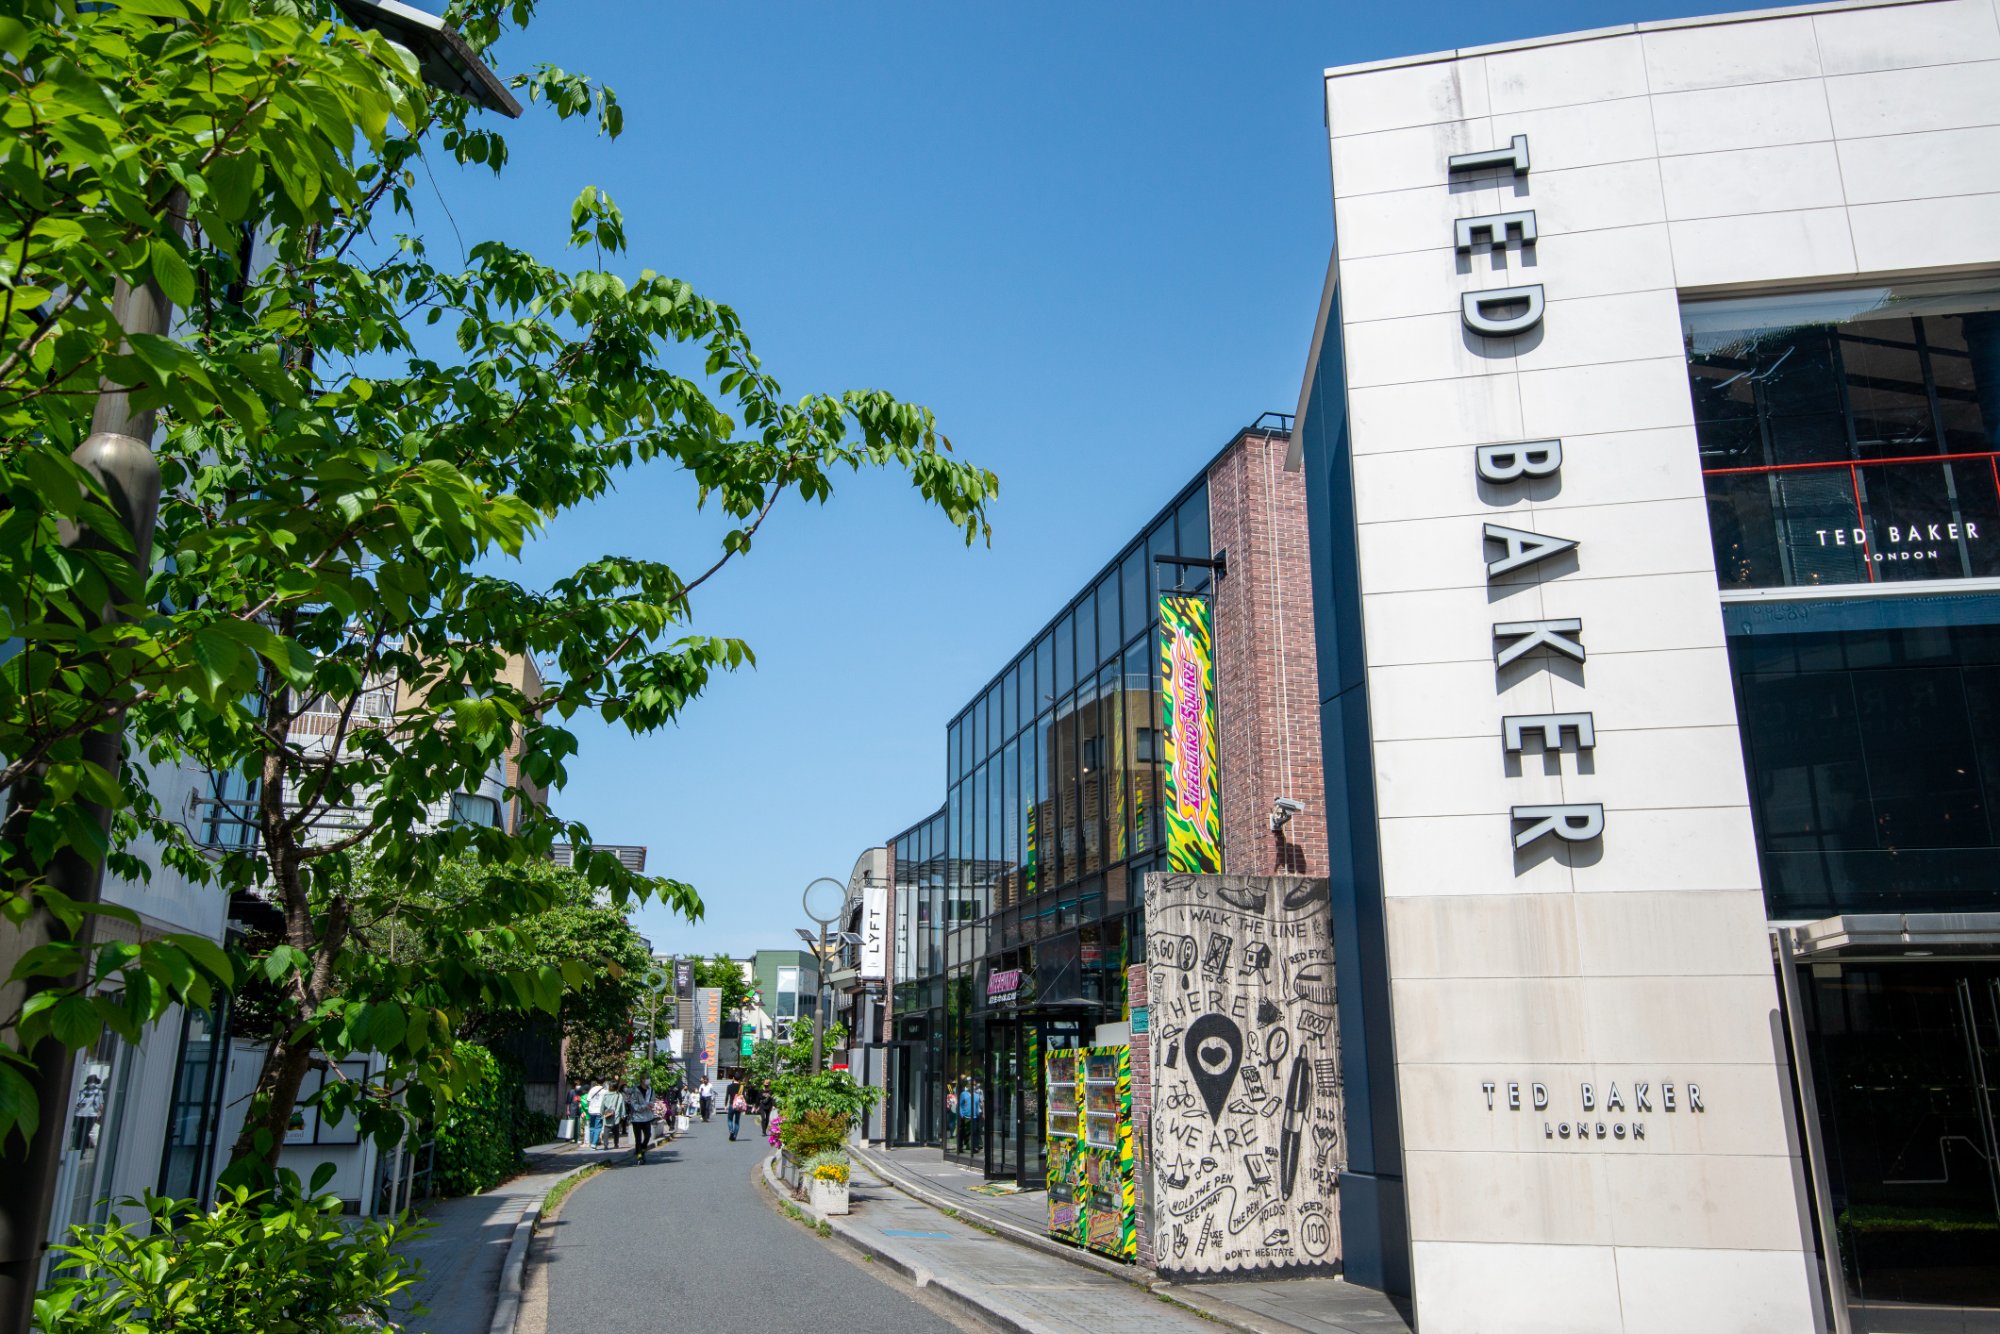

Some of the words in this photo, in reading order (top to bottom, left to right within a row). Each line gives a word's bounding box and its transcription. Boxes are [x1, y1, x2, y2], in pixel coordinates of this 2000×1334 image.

[1448, 134, 1546, 338] TED
[1816, 528, 1866, 546] TED
[1888, 522, 1979, 543] BAKER
[1863, 550, 1938, 562] LONDON
[1475, 438, 1606, 851] BAKER
[1179, 909, 1185, 922] I
[1189, 908, 1231, 927] WALK
[1239, 917, 1264, 934] THE
[1271, 923, 1307, 938] LINE
[1288, 952, 1307, 965] RED
[1308, 949, 1328, 960] EYE
[1216, 976, 1231, 985] OK
[707, 991, 719, 1024] JUNK
[1170, 990, 1248, 1019] HERE
[1304, 1014, 1325, 1030] 1000
[706, 1033, 717, 1066] YARD
[1482, 1081, 1549, 1111] TED
[1581, 1081, 1704, 1113] BAKER
[1316, 1106, 1335, 1122] BAD
[1170, 1117, 1203, 1148] WE
[1209, 1118, 1259, 1153] ARE
[1544, 1121, 1646, 1140] LONDON
[1309, 1167, 1332, 1184] IDEA
[1172, 1194, 1195, 1211] HOLD
[1195, 1181, 1211, 1200] THE
[1214, 1173, 1234, 1188] PEN
[1183, 1210, 1200, 1225] SEE
[1200, 1192, 1223, 1213] WHAT
[1232, 1212, 1246, 1229] THE
[1246, 1199, 1260, 1218] PEN
[1259, 1204, 1286, 1224] HOLDS
[1297, 1201, 1324, 1216] KEEP
[1209, 1230, 1225, 1240] USE
[1210, 1239, 1224, 1248] ME
[1306, 1223, 1326, 1245] 100
[1225, 1248, 1251, 1261] DON'T
[1254, 1247, 1295, 1258] HESITATE
